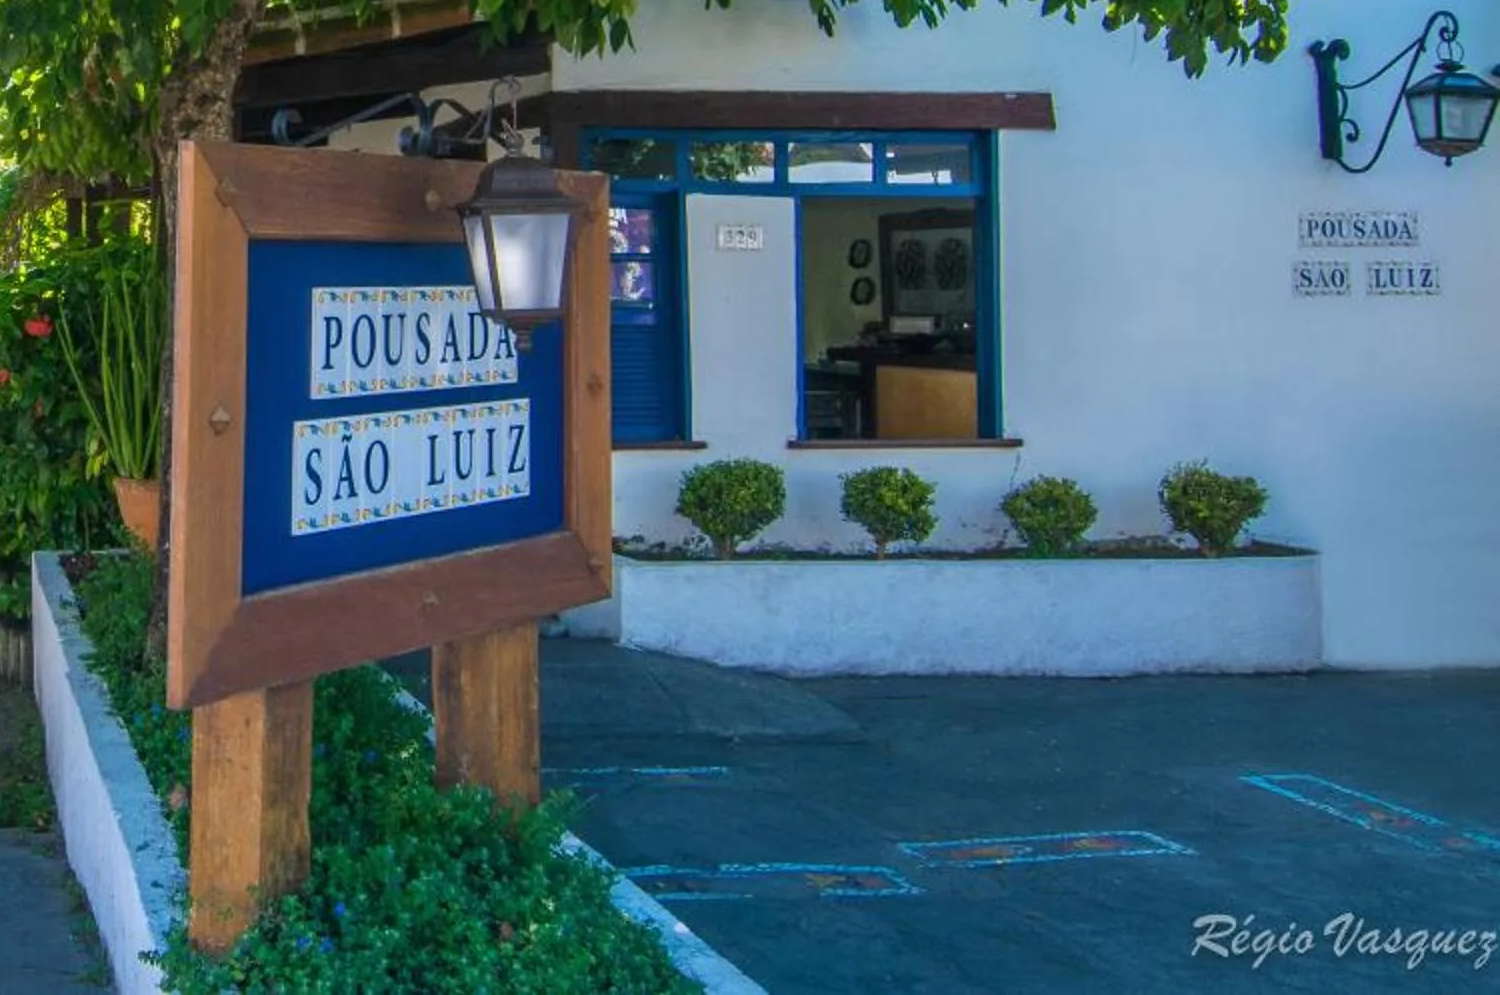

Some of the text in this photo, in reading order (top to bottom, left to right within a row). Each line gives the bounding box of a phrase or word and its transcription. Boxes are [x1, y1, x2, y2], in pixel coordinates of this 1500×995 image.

[1307, 218, 1414, 240] POUSADA
[1374, 268, 1434, 288] LUIZ
[321, 312, 515, 370] POUSADA
[304, 424, 527, 505] SÃO LUIZ
